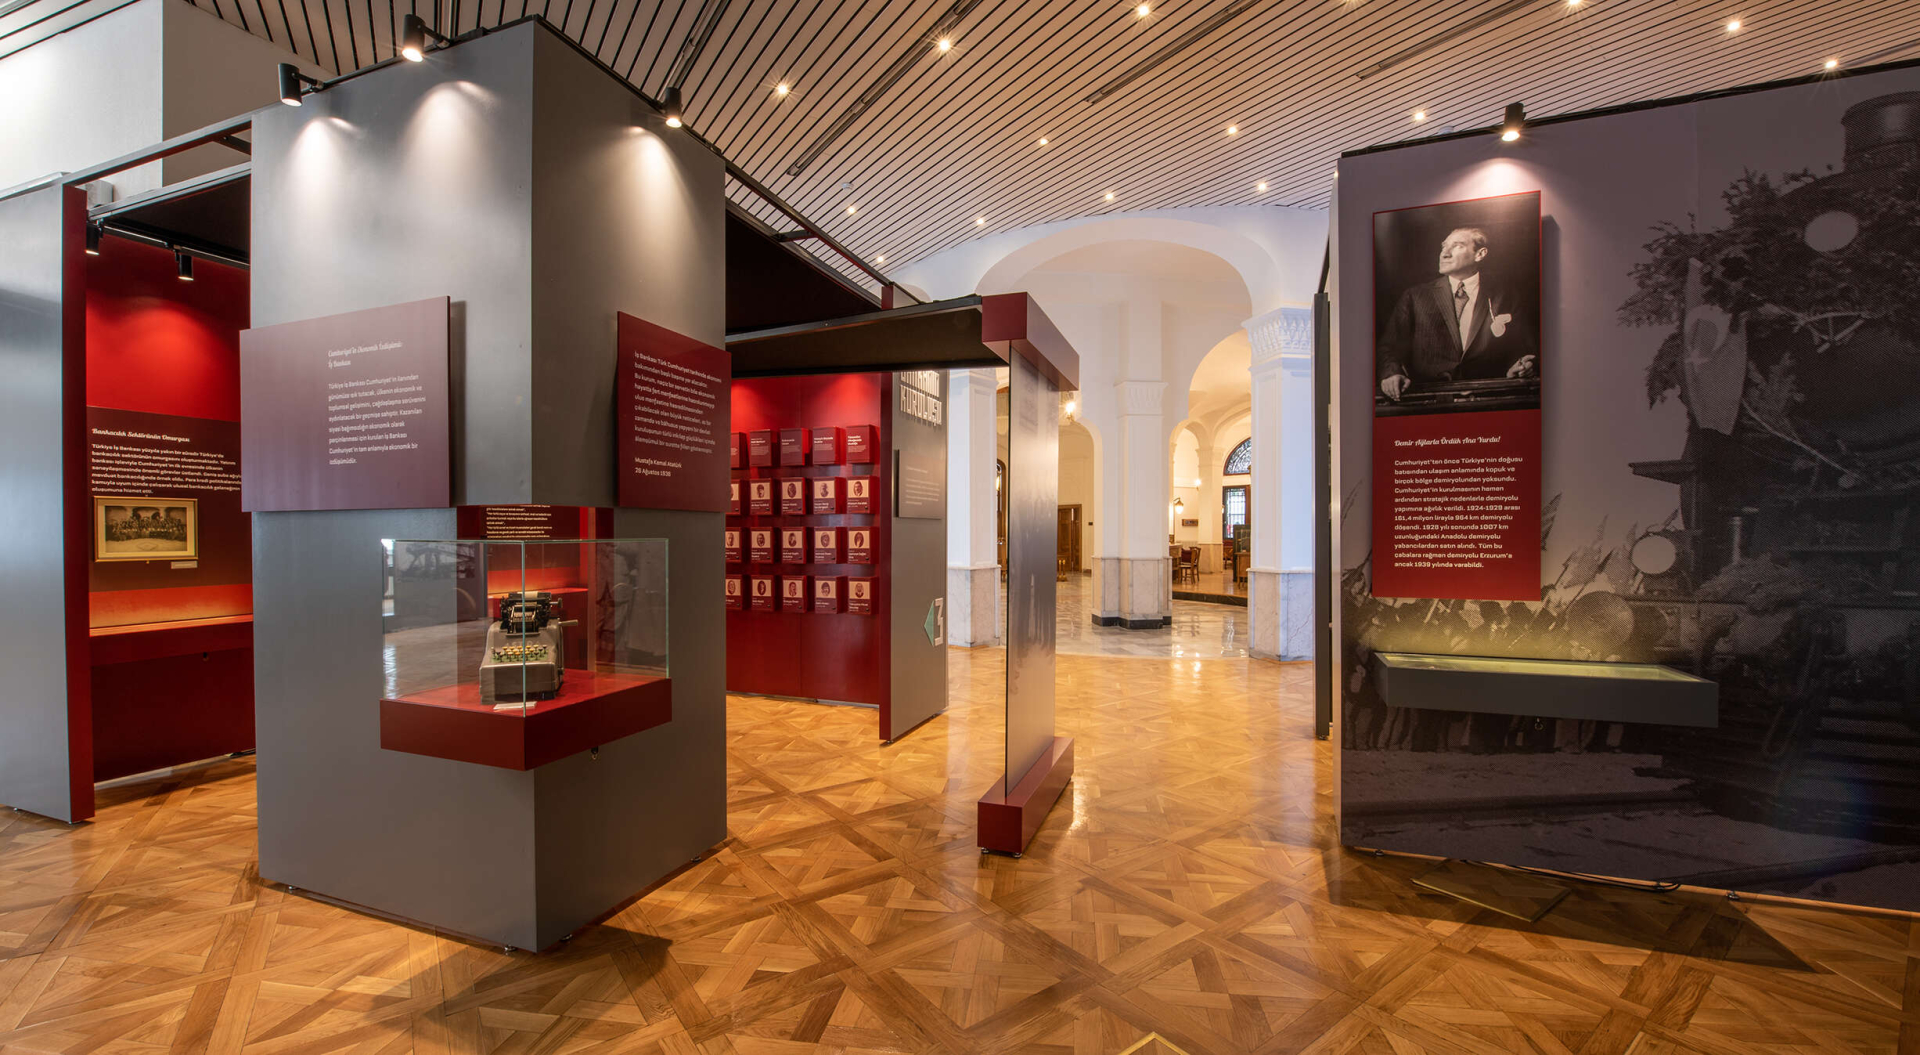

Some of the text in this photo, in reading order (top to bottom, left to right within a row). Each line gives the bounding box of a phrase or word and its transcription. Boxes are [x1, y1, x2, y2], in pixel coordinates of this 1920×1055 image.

[1415, 439, 1440, 447] Ağlarla
[1441, 437, 1461, 445] Ördük
[934, 598, 944, 647] 3
